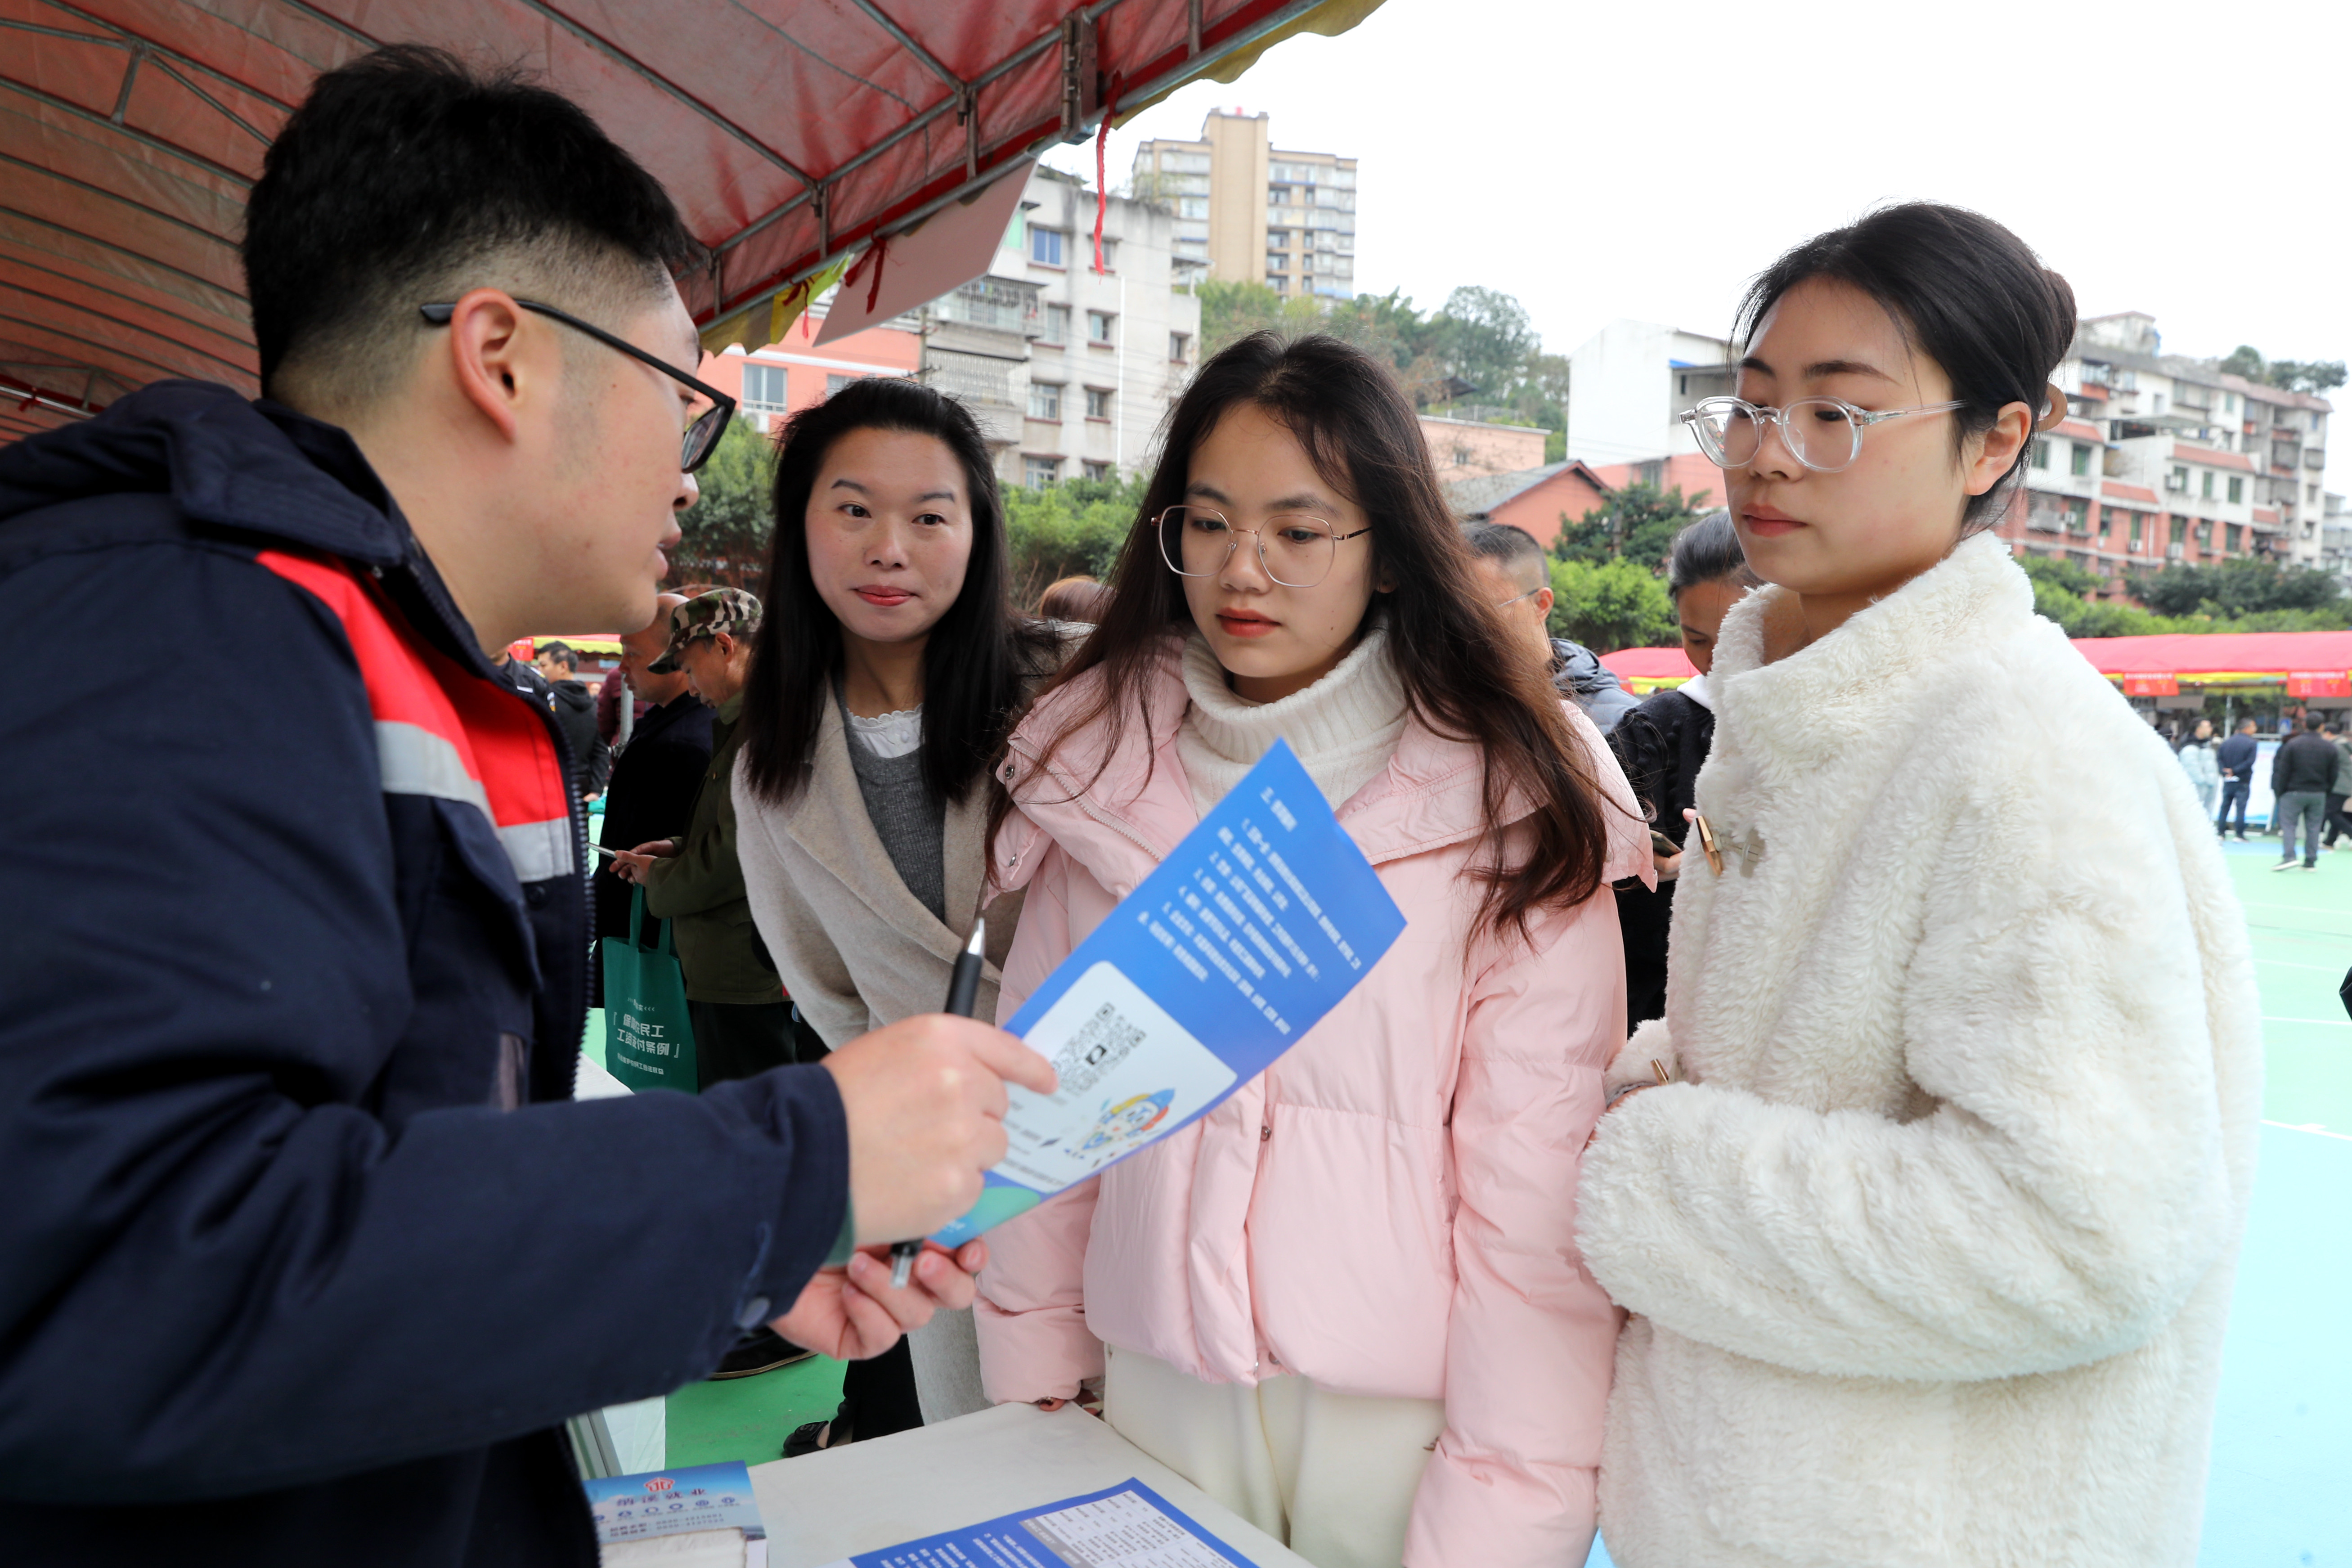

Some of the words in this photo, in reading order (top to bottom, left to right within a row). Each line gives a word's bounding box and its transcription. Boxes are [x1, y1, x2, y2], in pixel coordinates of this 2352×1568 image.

[617, 1028, 670, 1056] 工资支付条例
